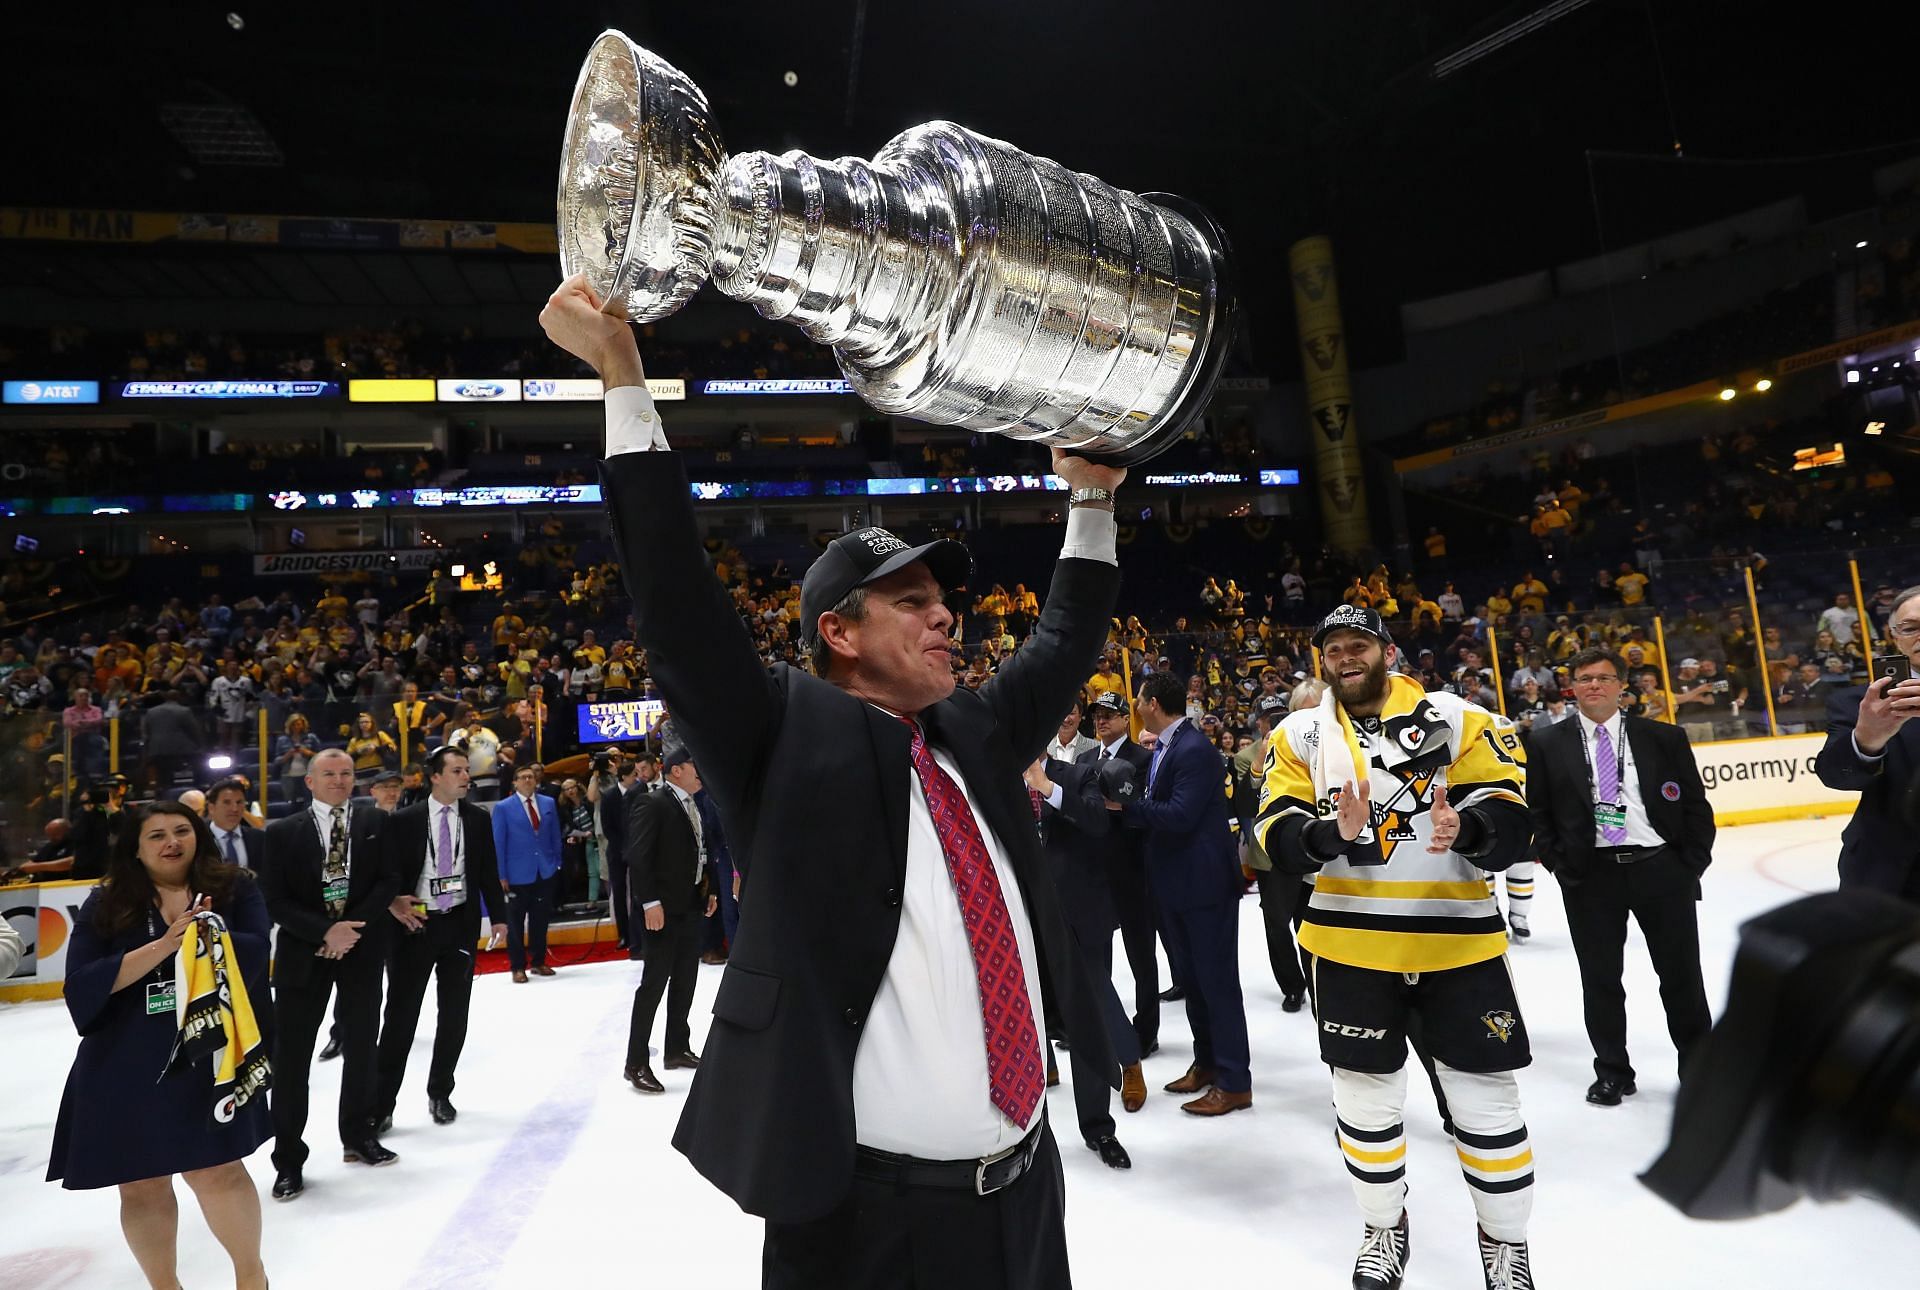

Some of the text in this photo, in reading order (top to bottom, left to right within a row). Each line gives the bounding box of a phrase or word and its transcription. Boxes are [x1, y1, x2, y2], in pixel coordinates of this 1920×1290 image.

[69, 209, 134, 240] MAN
[43, 385, 81, 398] AT&T
[128, 383, 197, 394] STANLEY
[194, 383, 227, 394] CUP
[226, 383, 277, 394] FINAL
[462, 383, 496, 397] Ford
[650, 384, 683, 395] STONE
[708, 381, 830, 391] STANLEY CUP FINAL
[1145, 475, 1190, 485] STANLEY
[263, 553, 434, 573] BRIDGESTON ARE
[589, 702, 636, 716] STAND
[1702, 757, 1817, 790] goarmy.c
[149, 1000, 162, 1009] ON
[162, 998, 175, 1006] ICE
[1323, 1020, 1388, 1041] CCM
